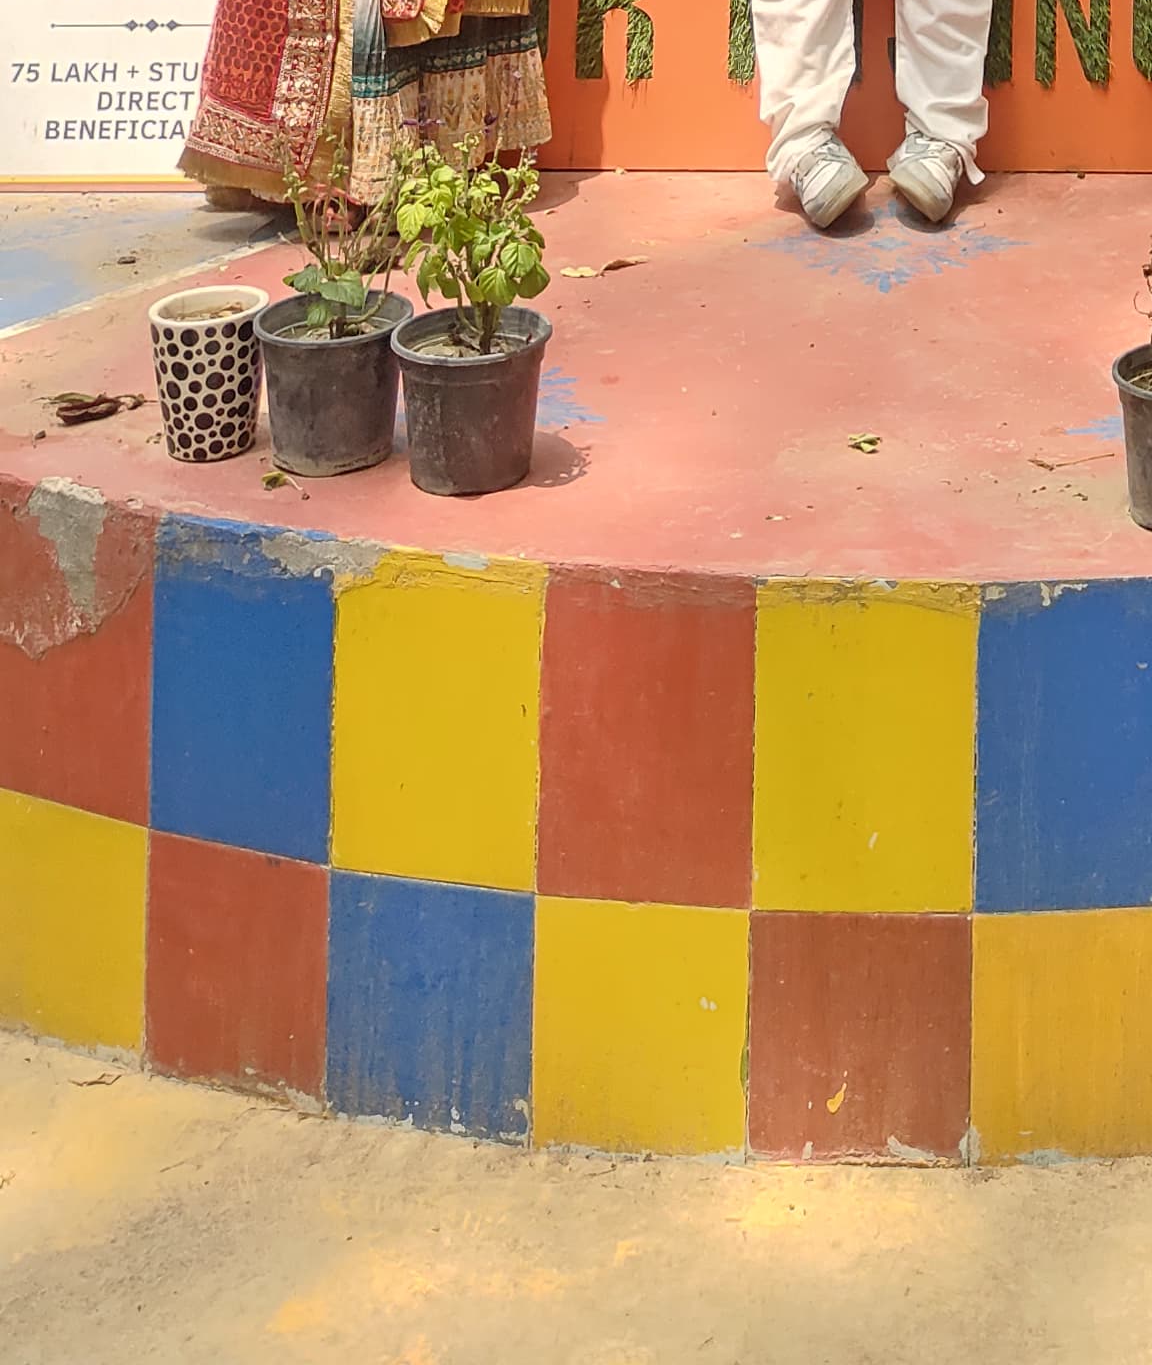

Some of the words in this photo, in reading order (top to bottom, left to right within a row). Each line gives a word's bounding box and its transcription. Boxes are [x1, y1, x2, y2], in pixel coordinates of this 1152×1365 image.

[11, 62, 40, 83] 75
[51, 61, 118, 83] LAKH
[126, 64, 139, 79] +
[150, 61, 199, 82] STU
[97, 90, 195, 112] DIRECT
[45, 119, 194, 141] BENEFICIA
